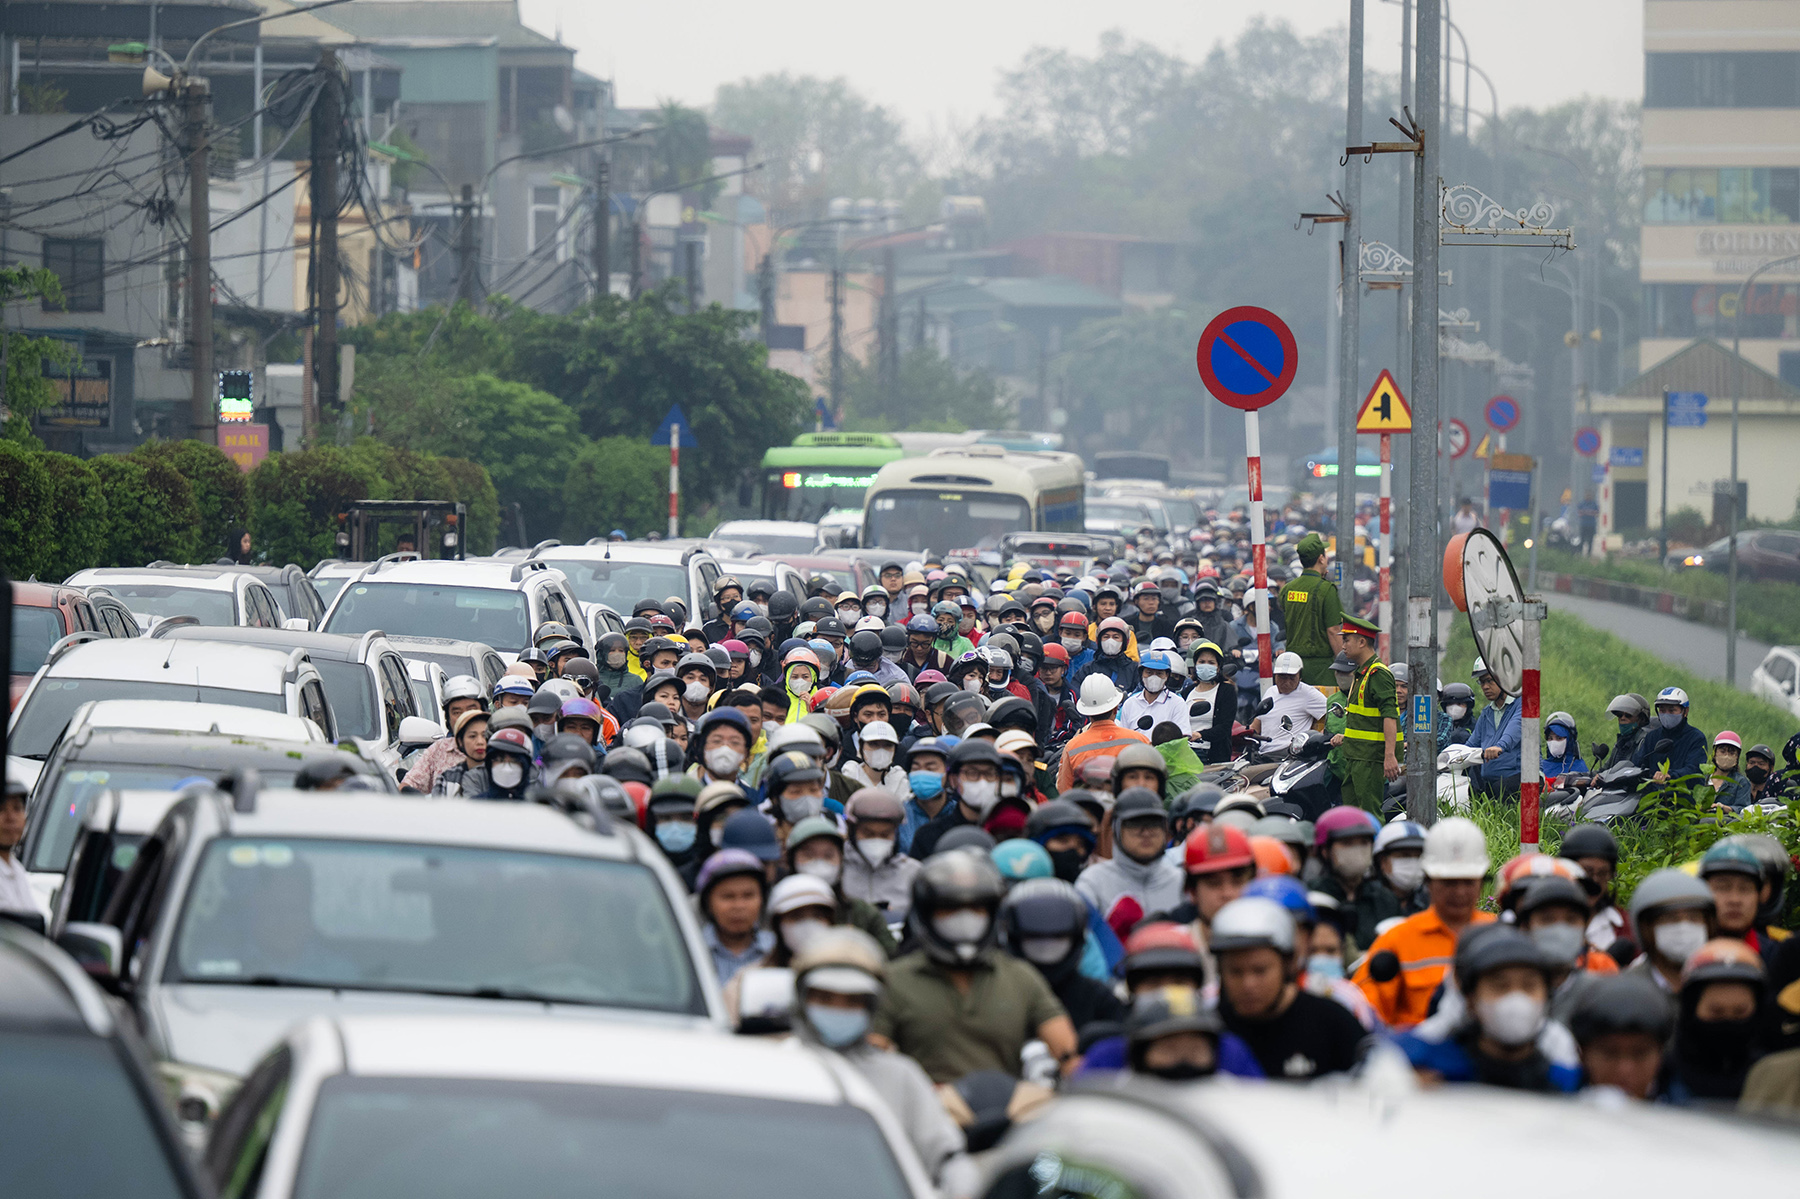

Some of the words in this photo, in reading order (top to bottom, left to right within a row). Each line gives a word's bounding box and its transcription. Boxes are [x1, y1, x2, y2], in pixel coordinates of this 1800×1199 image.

[225, 434, 261, 447] NAIL
[1289, 592, 1295, 600] CS
[1297, 593, 1306, 601] 113
